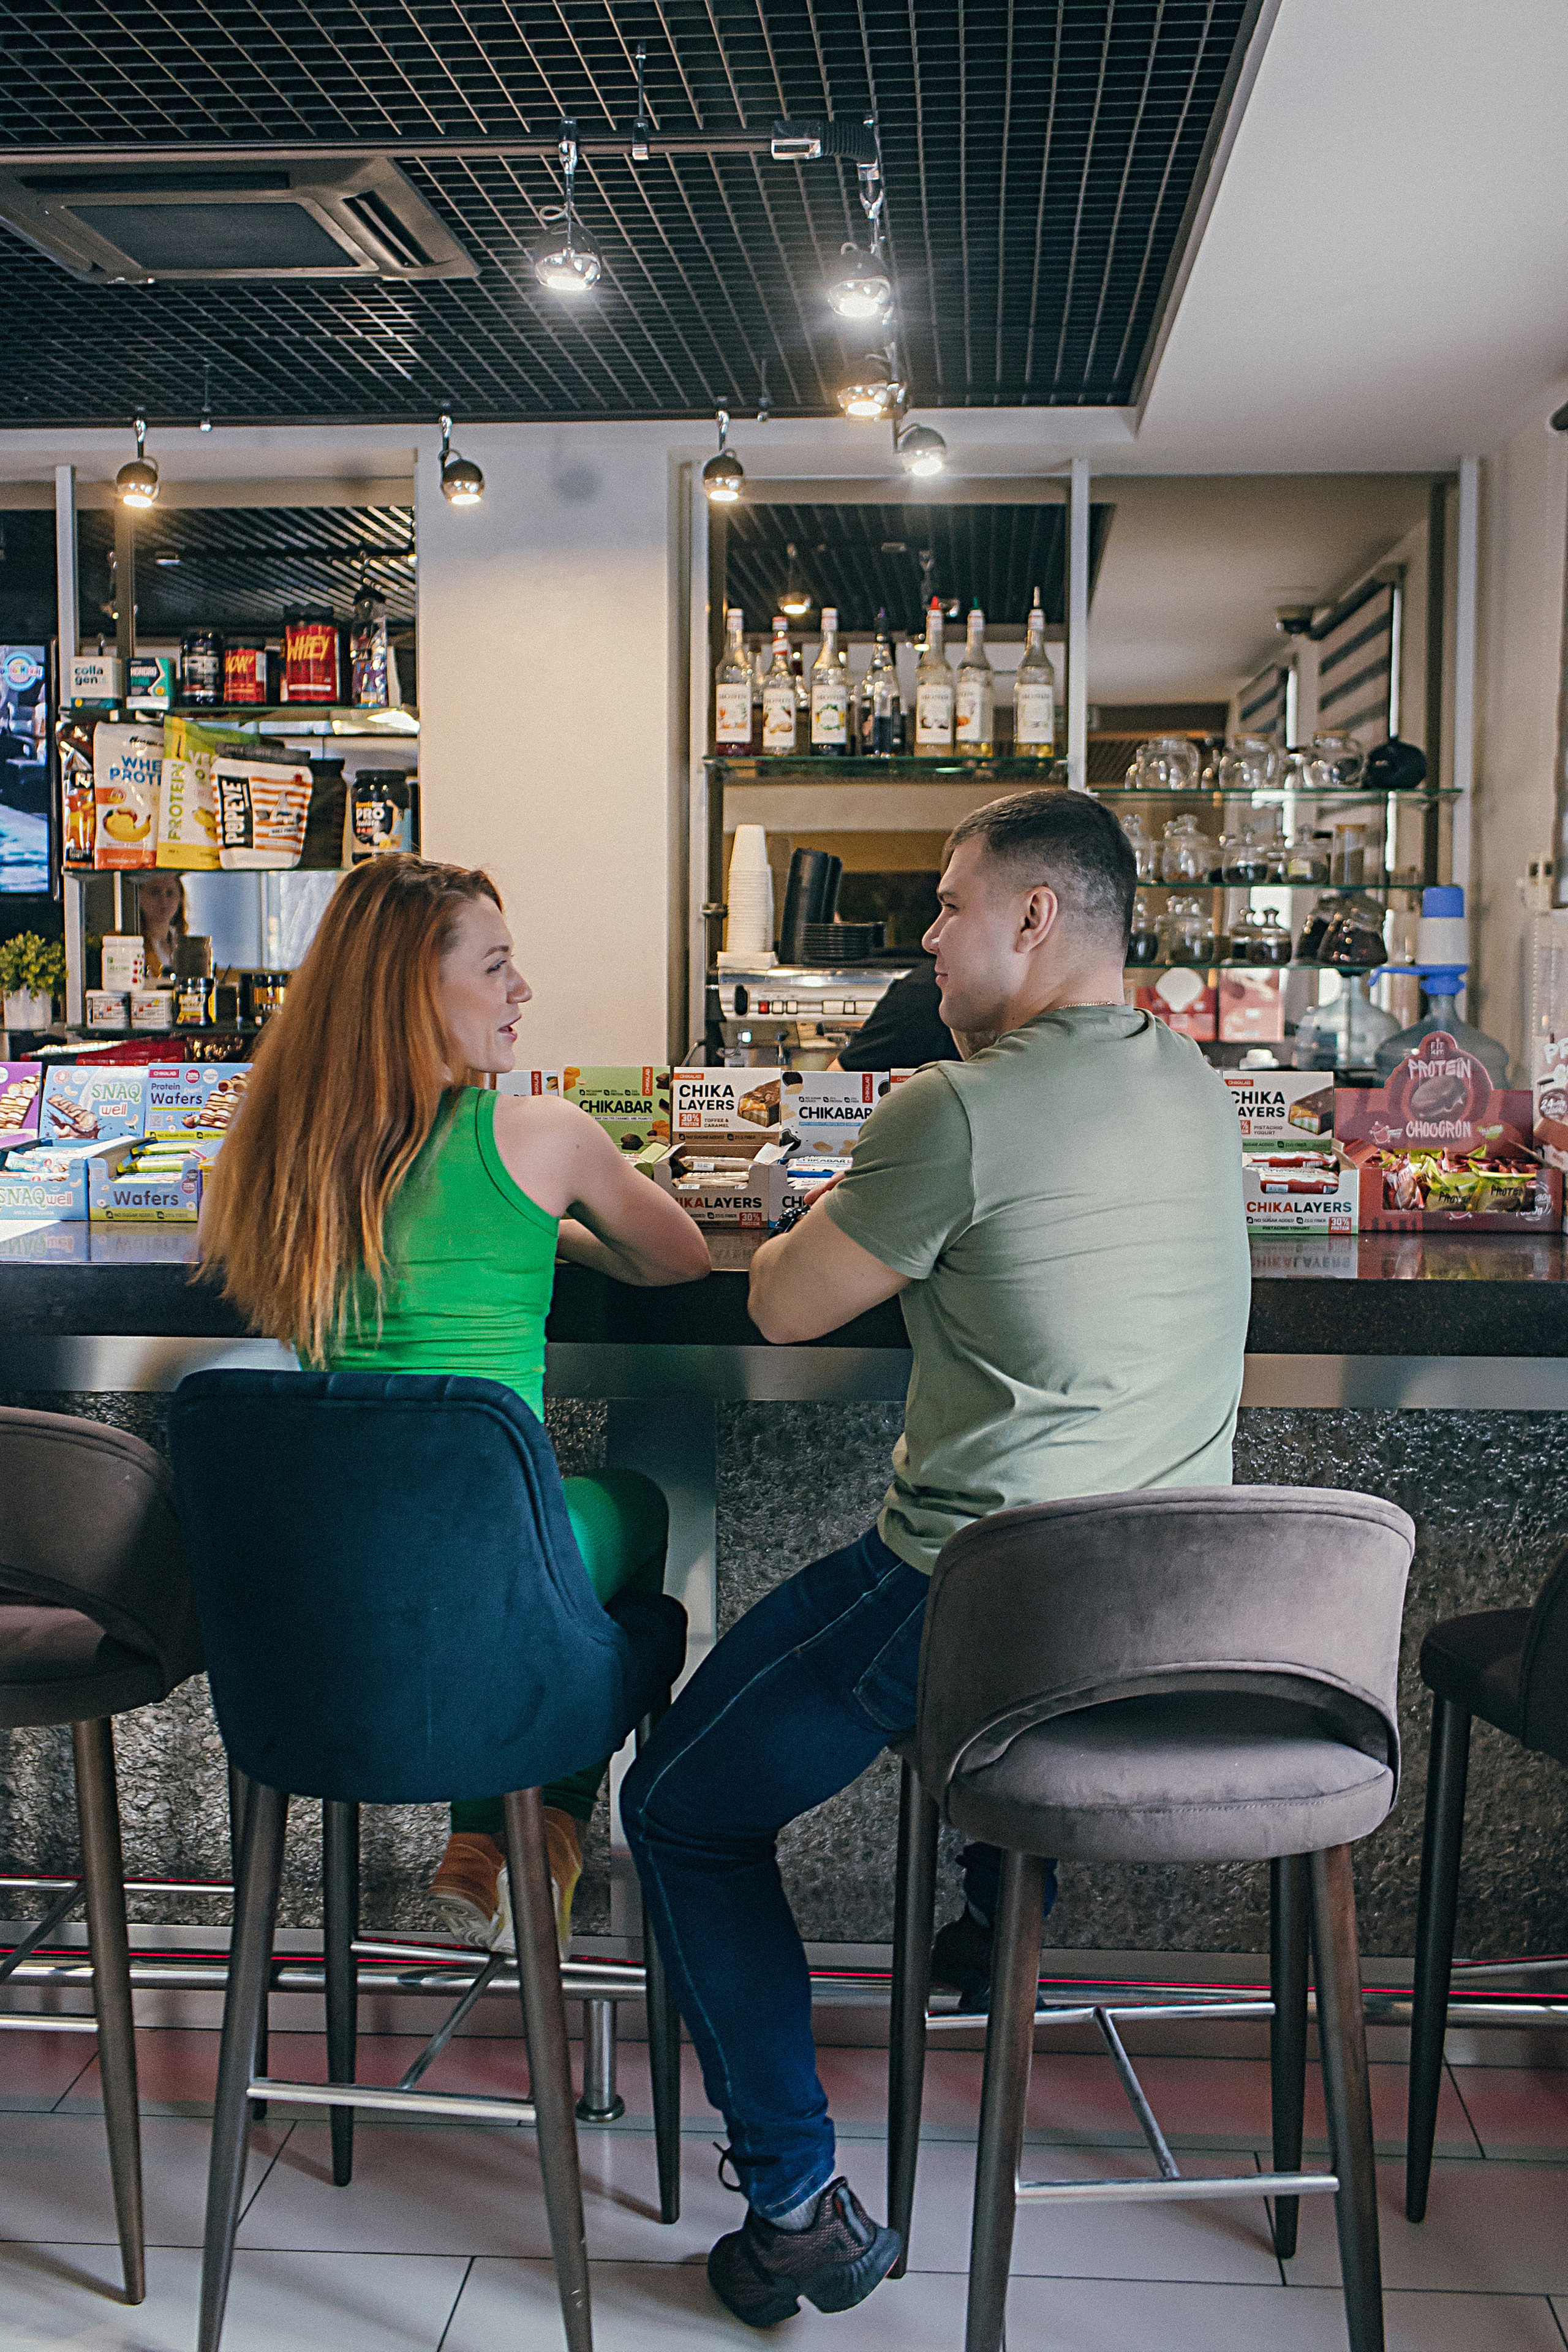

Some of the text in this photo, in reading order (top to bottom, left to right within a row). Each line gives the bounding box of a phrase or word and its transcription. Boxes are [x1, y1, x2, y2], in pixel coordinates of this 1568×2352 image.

[287, 635, 330, 662] WHEY
[74, 665, 104, 675] colla
[121, 755, 162, 769] WHE
[110, 767, 162, 786] PROT
[168, 763, 186, 840] PROTEIN
[221, 778, 246, 845] POPEYE
[356, 807, 385, 821] PRO
[1408, 1057, 1471, 1080] PROTEIN
[92, 1084, 141, 1102] SNAQ
[679, 1084, 734, 1098] CHIKA
[151, 1093, 203, 1104] Wafers
[679, 1099, 734, 1110] LAYERS
[101, 1102, 127, 1115] well
[579, 1099, 653, 1114] CHIKABAR
[1238, 1106, 1286, 1117] AYERS
[681, 1114, 699, 1122] 30%
[46, 1193, 72, 1205] well
[113, 1190, 179, 1206] Wafers
[675, 1197, 762, 1208] IKALAYERS
[1246, 1201, 1352, 1213] CHIKALAYERS
